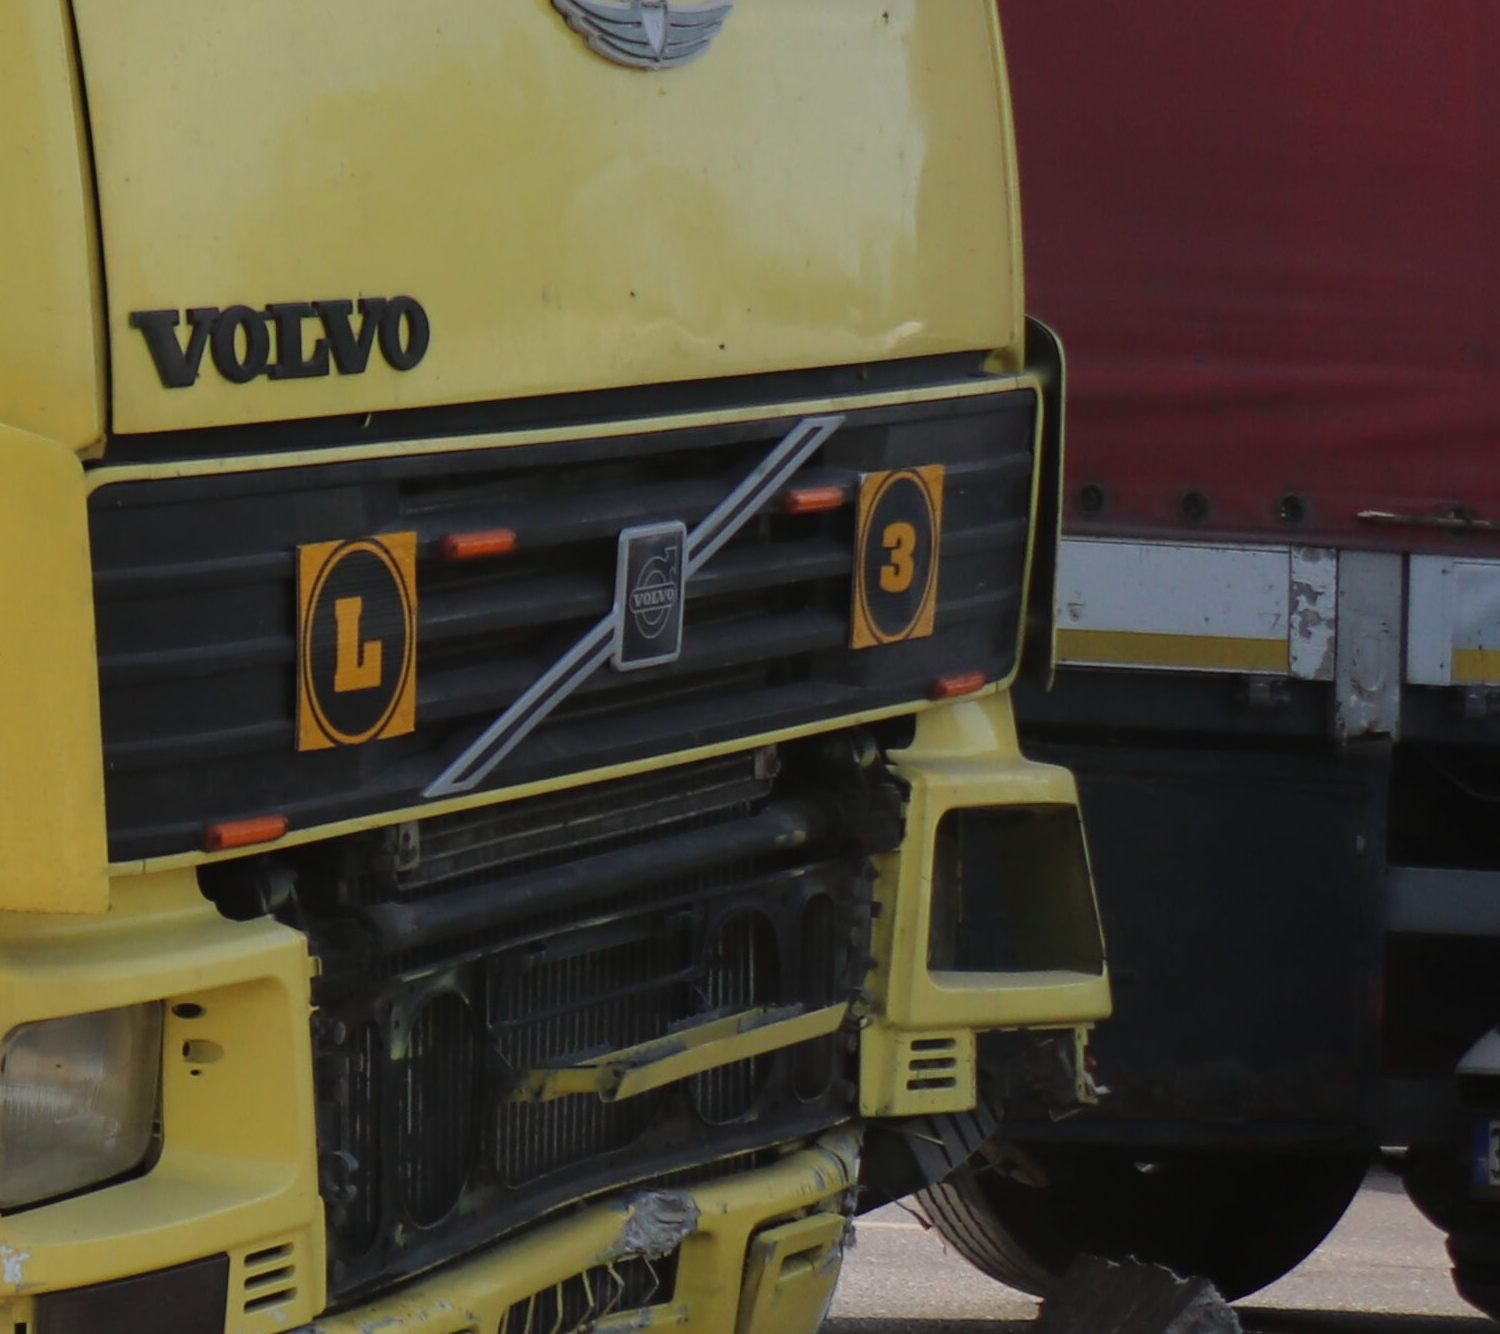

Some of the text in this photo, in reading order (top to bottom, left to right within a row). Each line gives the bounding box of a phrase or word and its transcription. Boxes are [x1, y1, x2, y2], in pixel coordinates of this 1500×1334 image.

[130, 294, 431, 389] VOLVO
[632, 589, 676, 608] VOLVO
[880, 521, 918, 594] 3
[332, 596, 383, 694] L
